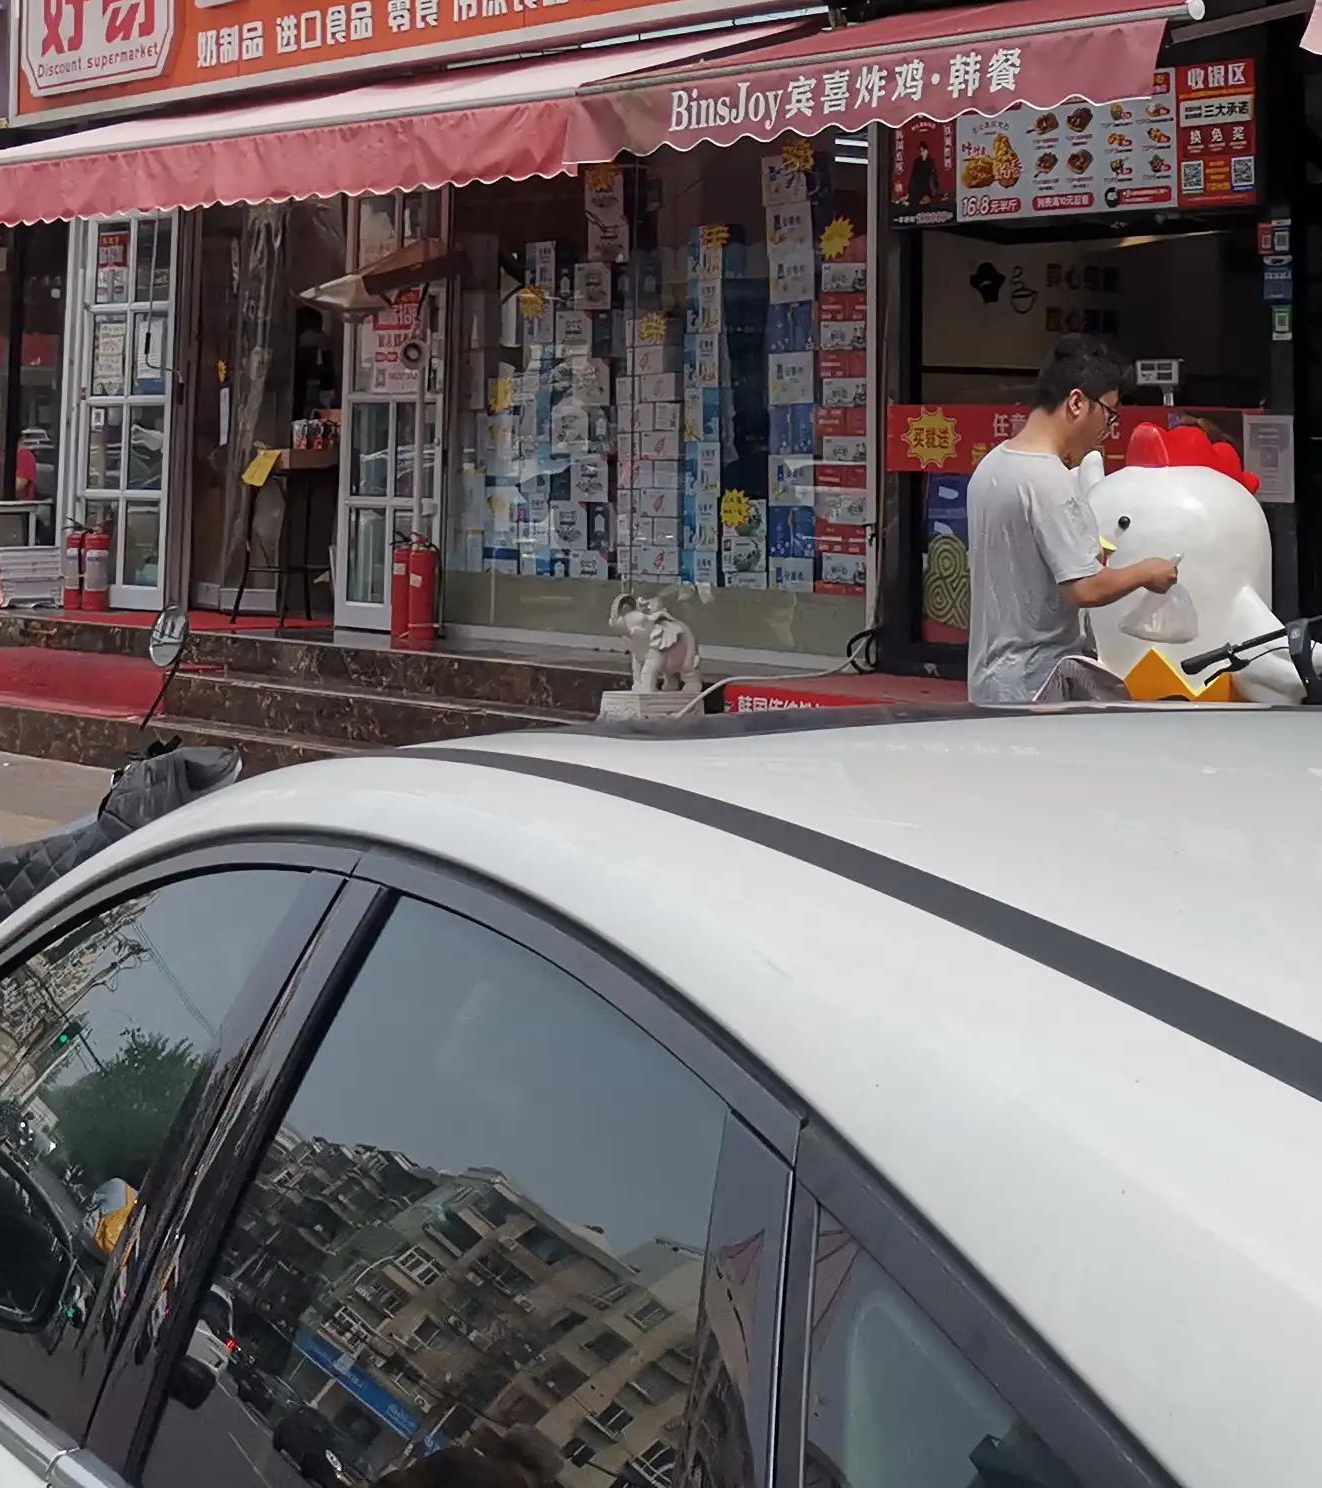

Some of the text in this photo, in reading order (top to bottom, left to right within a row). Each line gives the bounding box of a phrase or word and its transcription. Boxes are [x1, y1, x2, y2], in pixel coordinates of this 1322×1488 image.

[196, 20, 264, 69] 奶制品
[275, 0, 373, 54] 进口食品
[37, 40, 160, 78] Discount supermarket
[1187, 63, 1247, 90] 收银区
